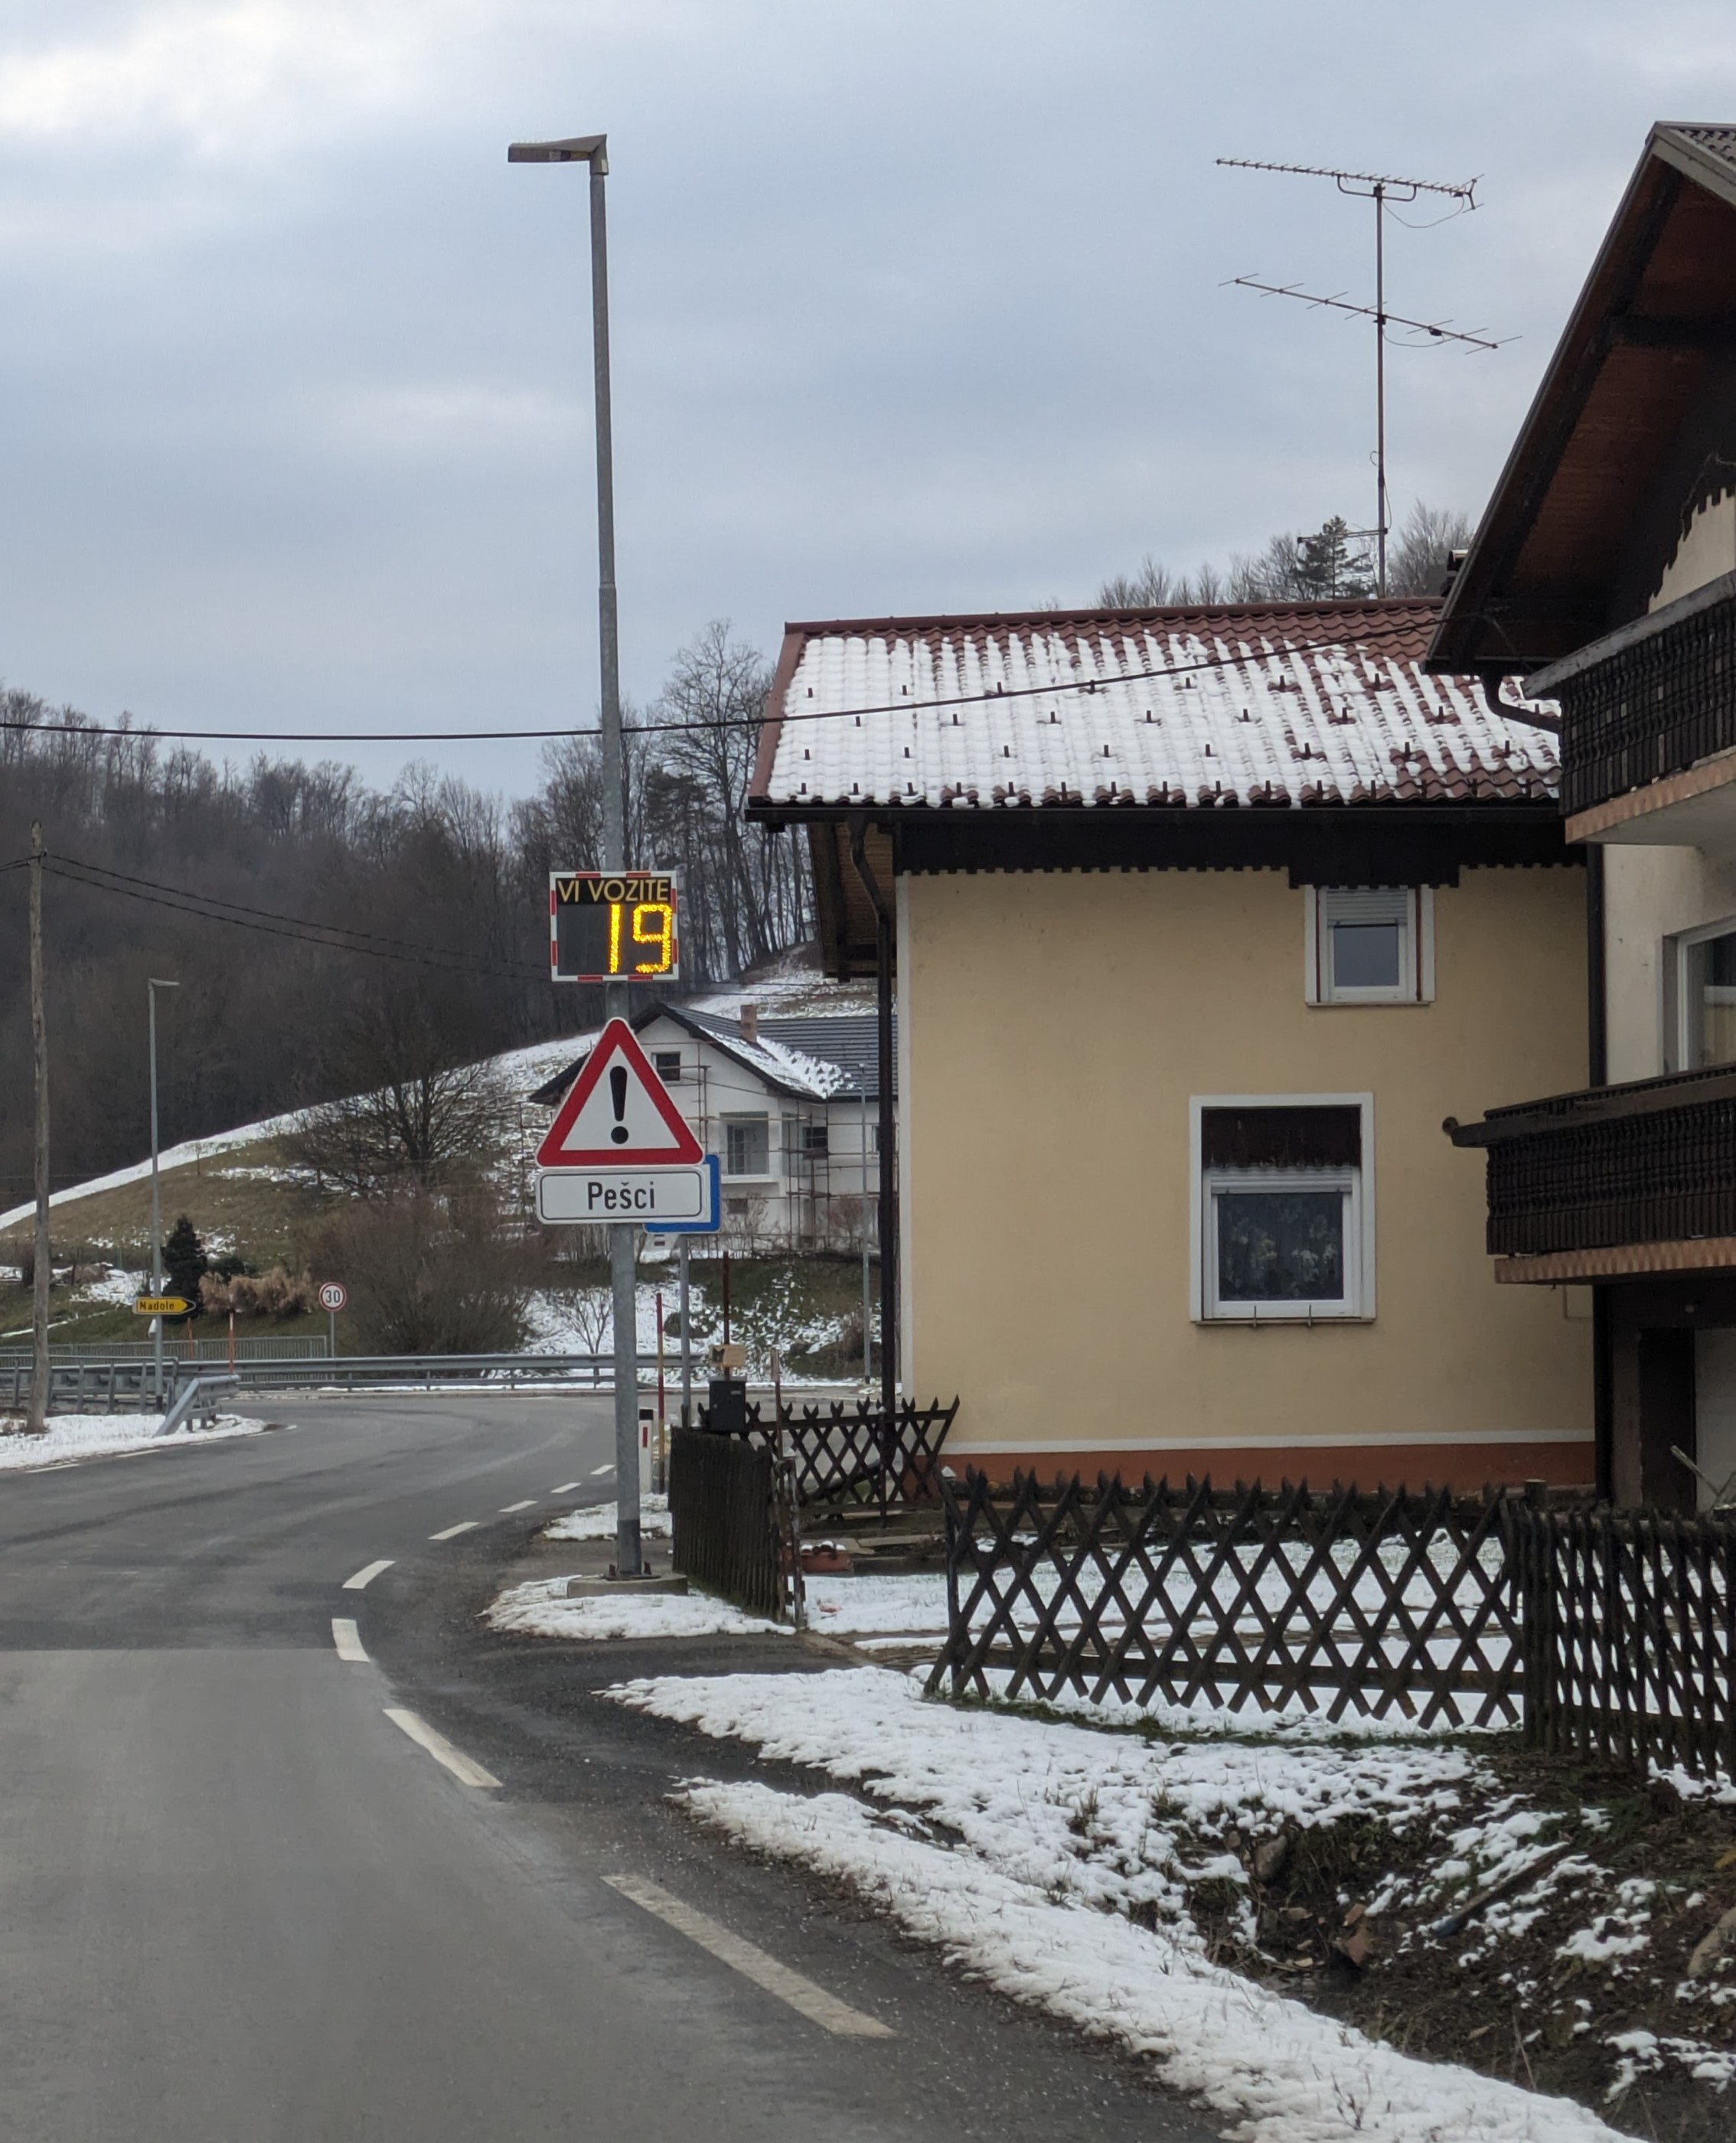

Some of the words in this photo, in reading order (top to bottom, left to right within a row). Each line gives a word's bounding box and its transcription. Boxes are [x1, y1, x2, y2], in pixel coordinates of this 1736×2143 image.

[557, 879, 579, 902] VI
[588, 879, 669, 902] VOZITE
[609, 903, 672, 974] 19
[588, 1181, 655, 1210] Pešci
[325, 1290, 341, 1303] 30
